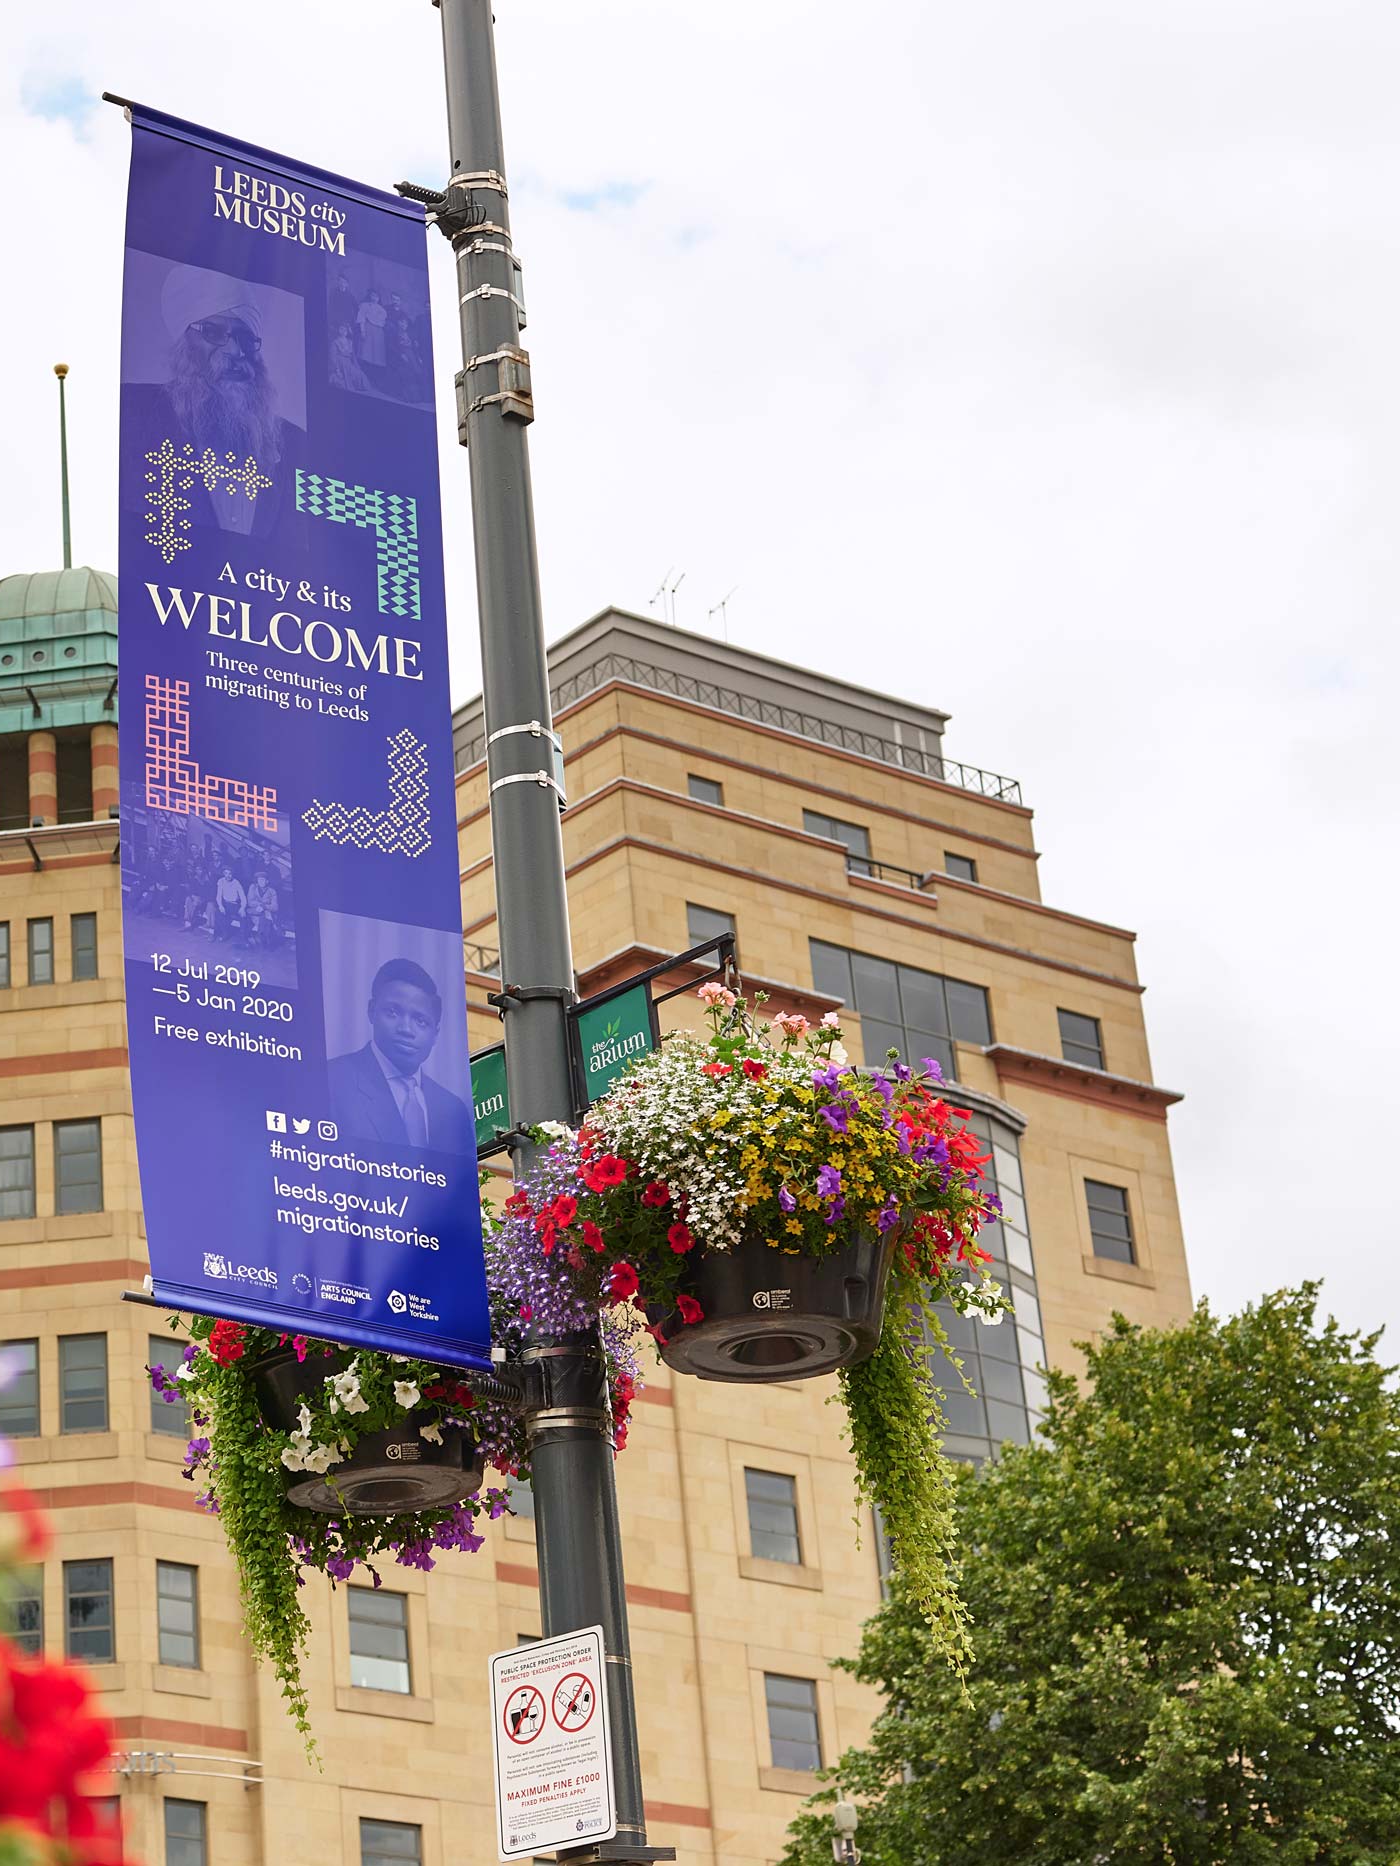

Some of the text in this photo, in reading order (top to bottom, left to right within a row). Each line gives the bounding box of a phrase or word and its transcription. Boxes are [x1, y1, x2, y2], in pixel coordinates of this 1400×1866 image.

[214, 166, 346, 228] LEEDS city
[214, 193, 346, 256] MUSEUM
[218, 561, 352, 612] A city & its
[144, 582, 424, 681] WELCOME
[206, 650, 368, 701] Three centuries of
[205, 673, 369, 722] migrating to Leeds
[150, 953, 260, 990] 12 Jul 2019
[196, 989, 236, 1012] Jan
[242, 996, 293, 1022] 2020
[154, 1016, 301, 1061] Free exhibition
[592, 1037, 614, 1053] the
[269, 1139, 447, 1188] #migrationstories
[273, 1176, 409, 1218] leeds.gov.uk/
[277, 1207, 440, 1251] migrationstories
[227, 1261, 278, 1284] Leeds
[249, 1280, 279, 1290] COUNCIL
[320, 1284, 340, 1293] ARTS
[341, 1287, 373, 1301] COUNCIL
[321, 1292, 356, 1305] ENGLAND
[408, 1293, 431, 1305] We are
[409, 1301, 425, 1311] West
[410, 1309, 439, 1321] Yorkshire
[501, 1666, 519, 1676] PUBLIC
[520, 1661, 536, 1671] SPACE
[538, 1652, 571, 1666] PROTECTION
[573, 1647, 591, 1657] ORDER
[501, 1671, 530, 1683] RESTRICTED
[579, 1655, 592, 1664] AREA
[507, 1772, 600, 1801] MAXIMUM FINE £1000
[521, 1788, 586, 1807] FIXED PENALTIES APPLY
